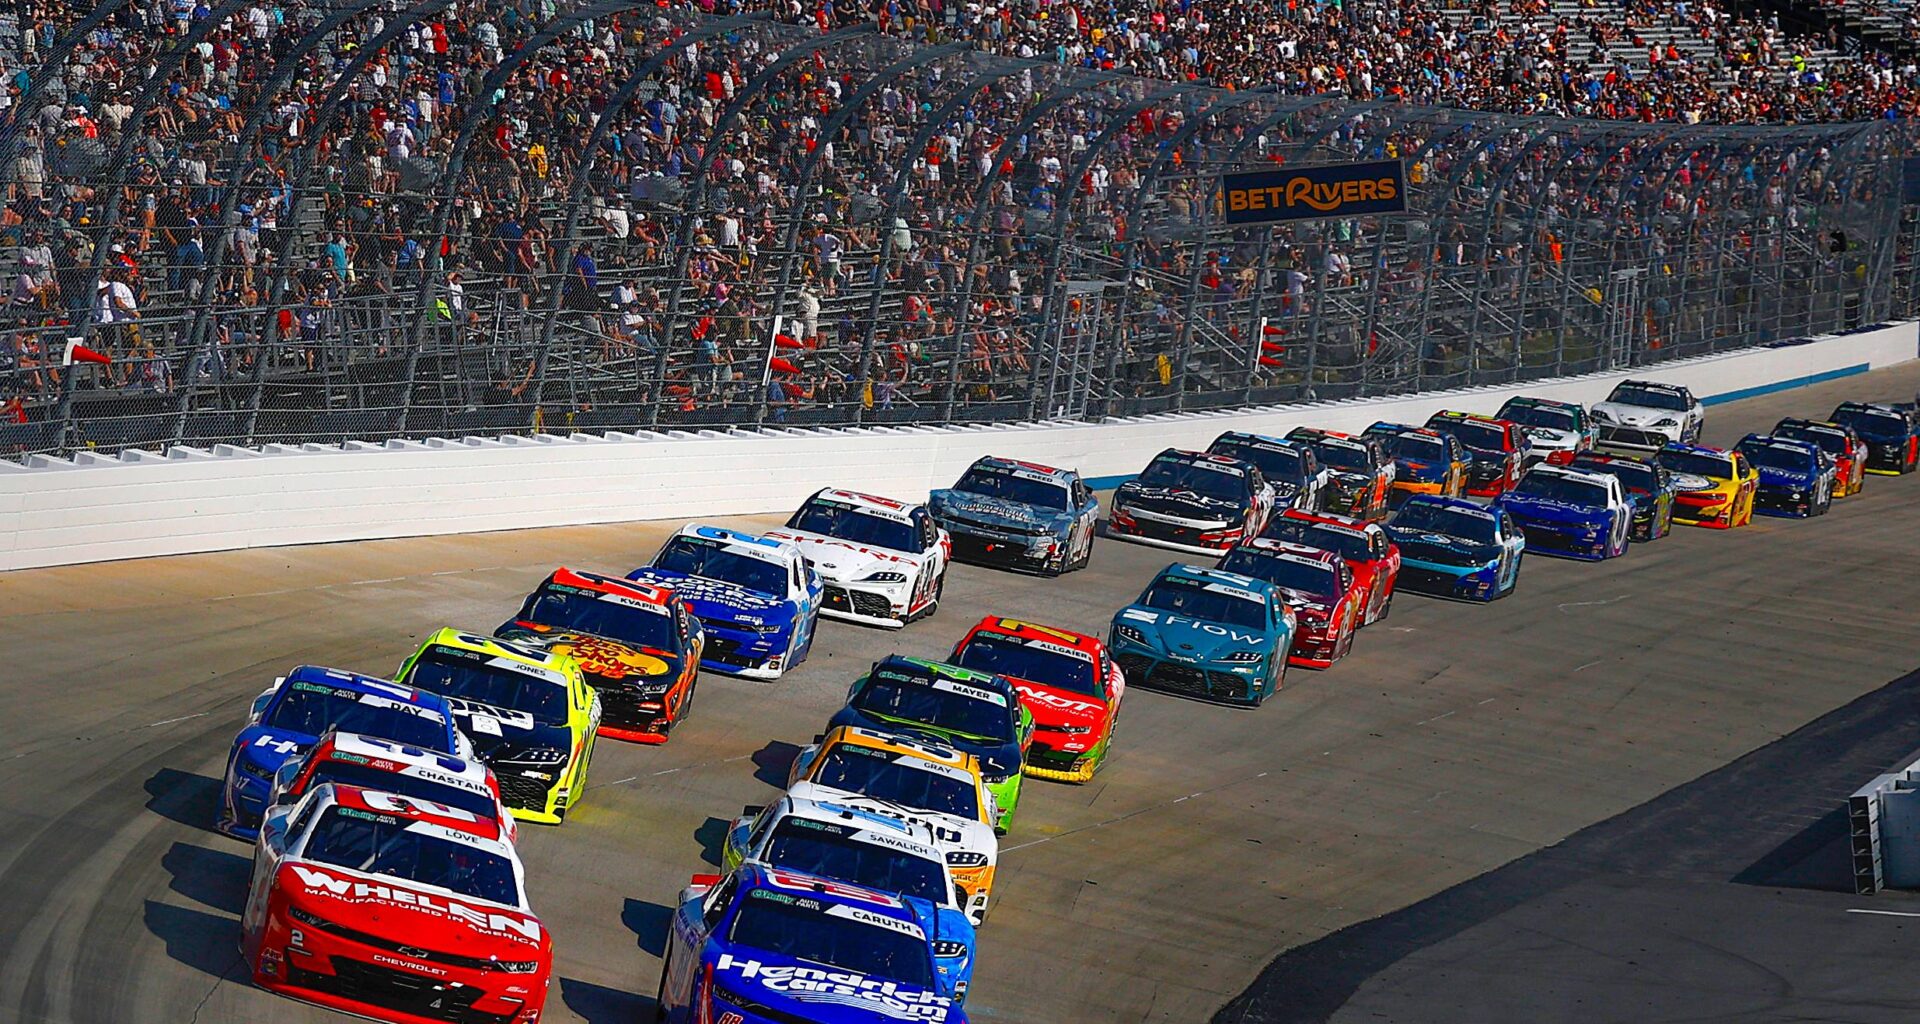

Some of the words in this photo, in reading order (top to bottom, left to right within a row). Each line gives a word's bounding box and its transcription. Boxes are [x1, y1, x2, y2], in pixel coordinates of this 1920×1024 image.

[1229, 177, 1397, 211] BETRIVERS
[1026, 474, 1053, 483] CREED
[869, 510, 906, 522] BURTON
[748, 550, 766, 559] HILL
[1223, 587, 1250, 597] CREWS
[620, 597, 659, 612] KVAPIL
[1040, 643, 1089, 658] ALLGAIER
[515, 664, 546, 677] JONES
[952, 685, 991, 699] MAYER
[391, 702, 423, 717] DAY
[923, 762, 953, 774] GRAY
[418, 770, 489, 794] CHASTAIN
[445, 829, 479, 844] LOVE
[870, 834, 928, 855] SAWALICH
[290, 865, 541, 942] WHELEN
[304, 887, 443, 918] MANUFACTURED
[447, 915, 464, 924] IN
[467, 923, 540, 950] AMERICA
[852, 910, 911, 933] CARUTH
[291, 929, 304, 947] 2
[373, 954, 448, 977] CHEVROLET
[716, 953, 952, 1007] Hendrick
